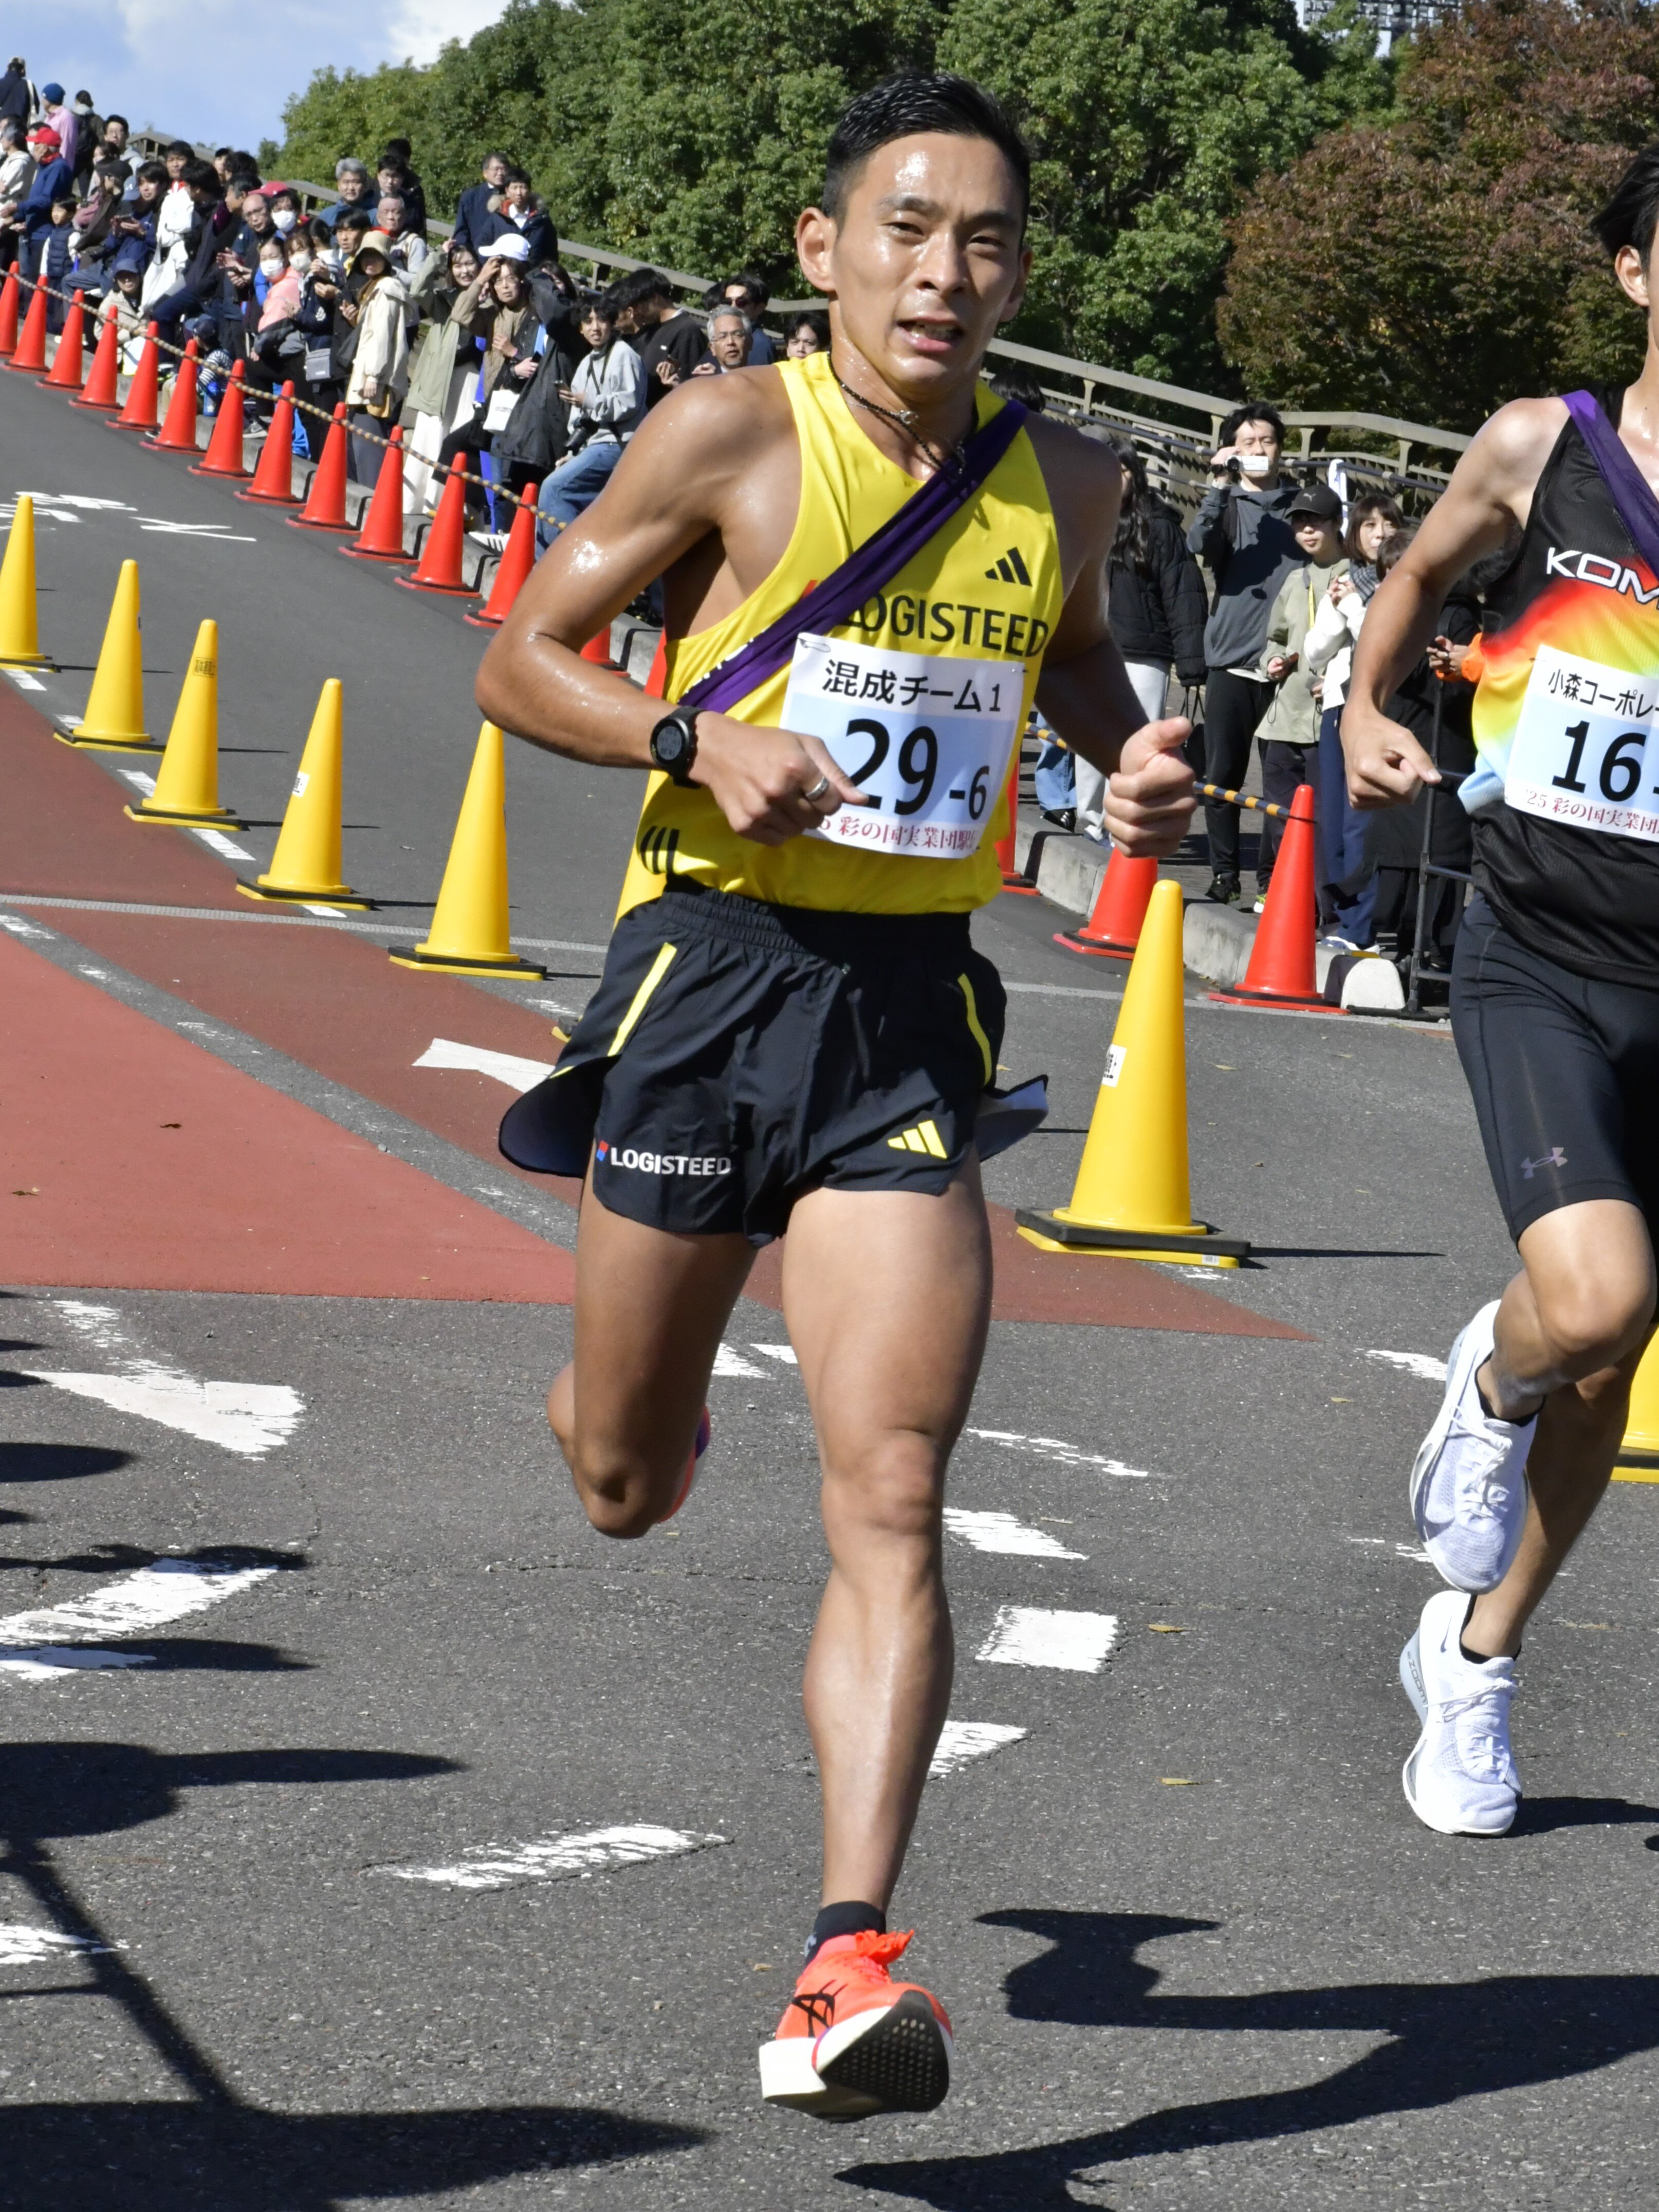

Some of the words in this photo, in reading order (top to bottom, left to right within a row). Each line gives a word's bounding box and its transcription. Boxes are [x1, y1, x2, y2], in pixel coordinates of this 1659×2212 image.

[1548, 669, 1659, 718] 小森コーポレ
[846, 718, 990, 820] 29-6
[1552, 797, 1659, 834] 彩の国実業団
[610, 1146, 731, 1176] LOGISTEED
